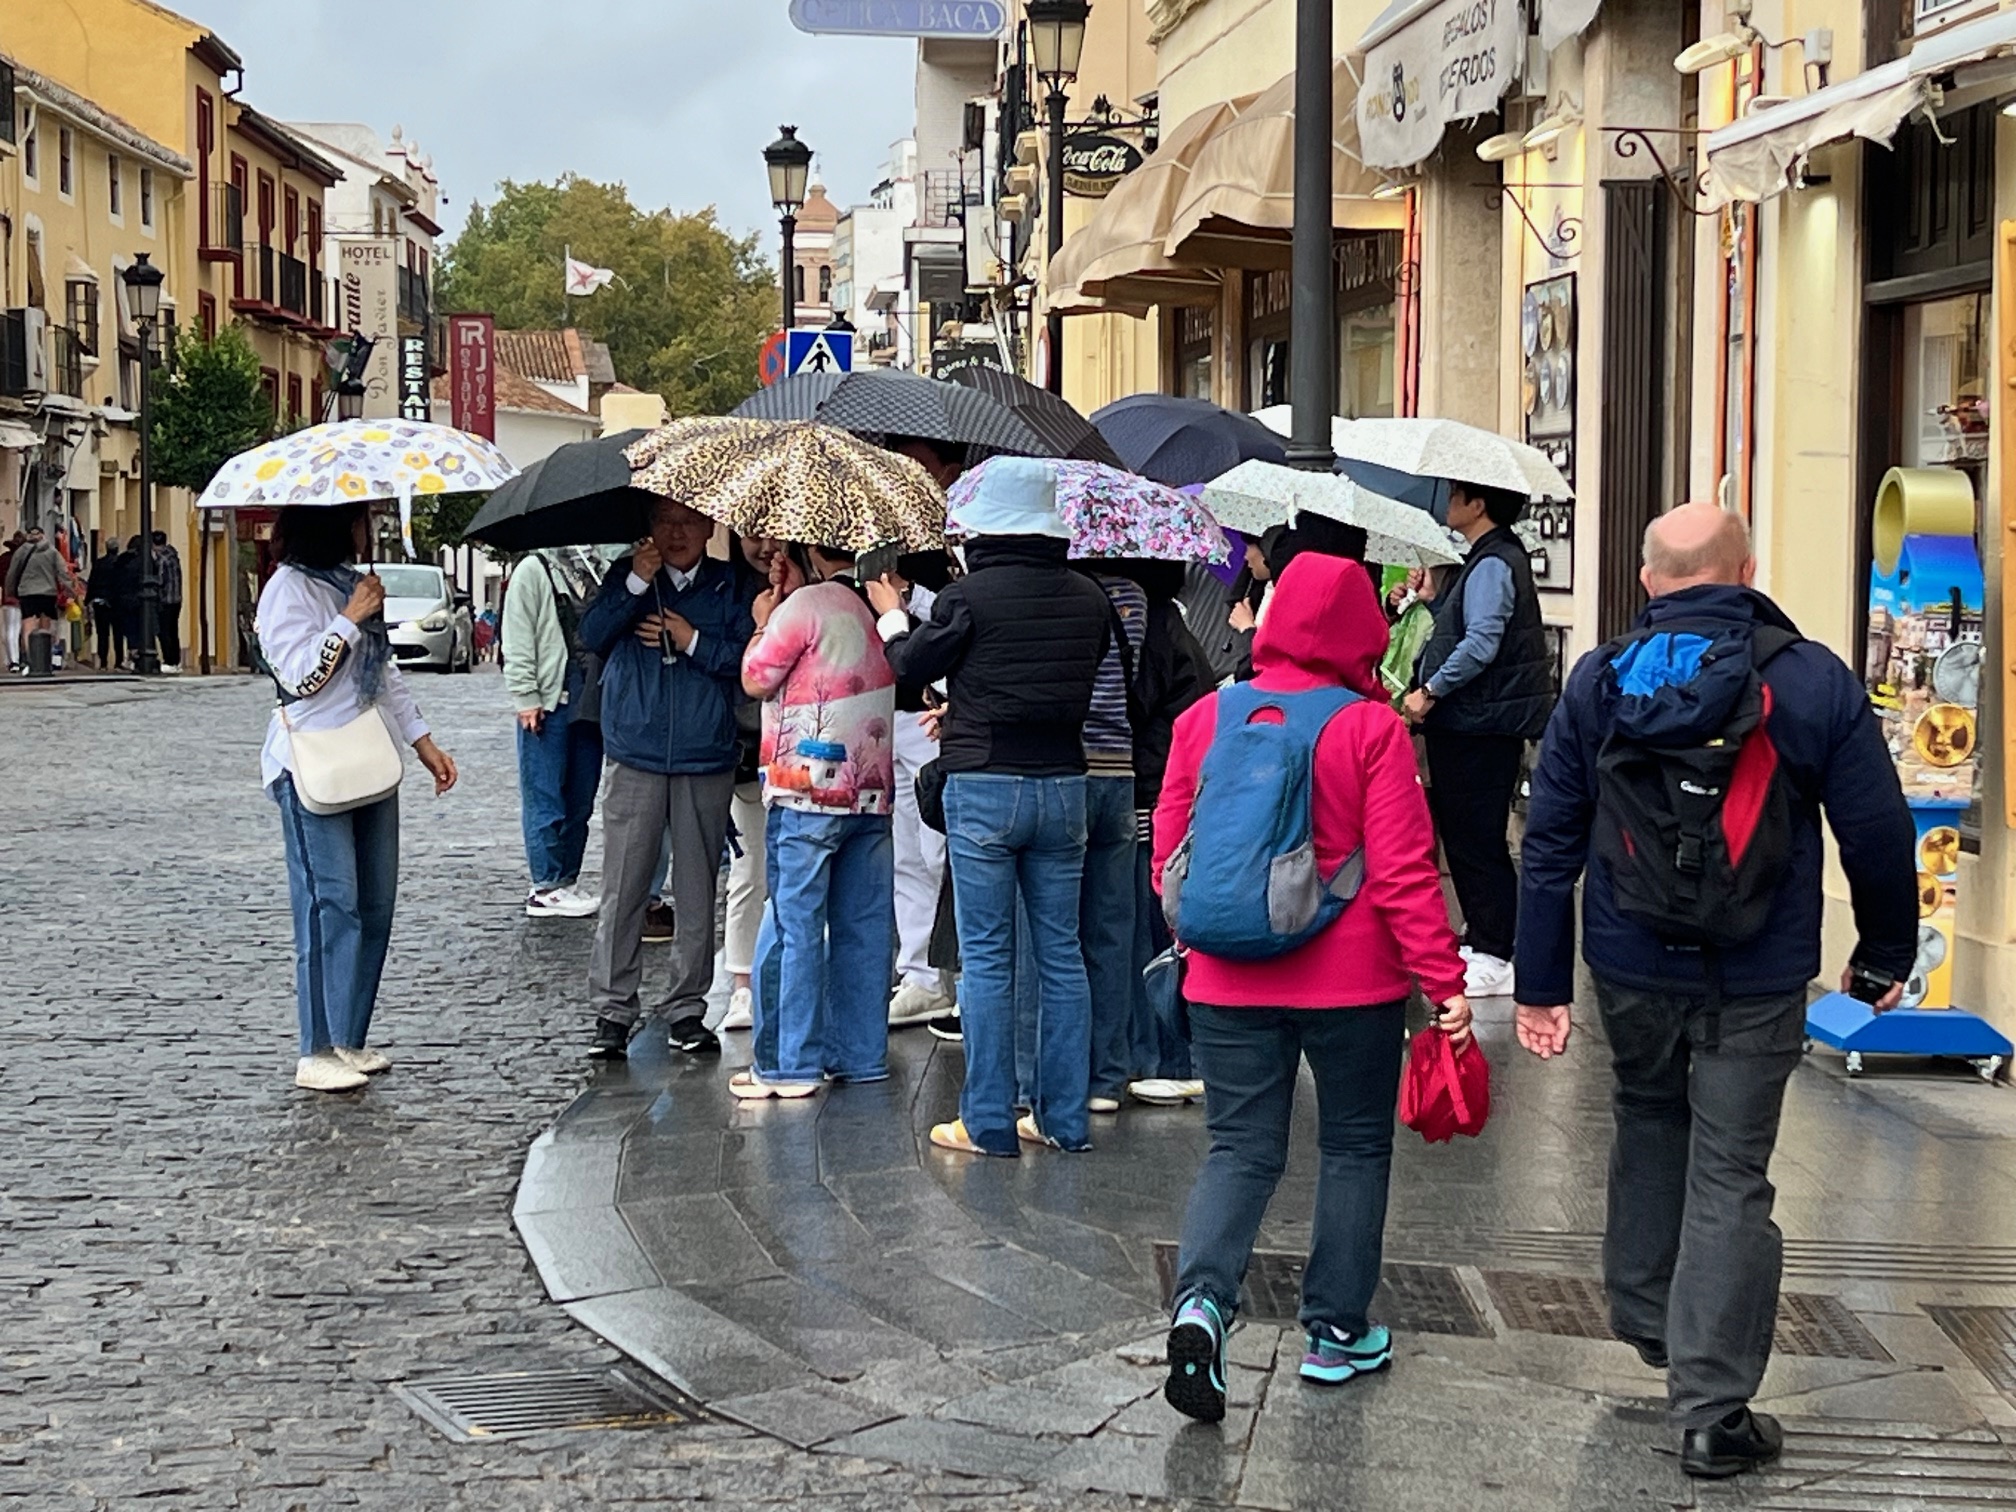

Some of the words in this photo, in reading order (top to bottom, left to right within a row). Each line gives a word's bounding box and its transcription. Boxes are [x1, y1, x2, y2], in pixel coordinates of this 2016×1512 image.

[918, 2, 992, 31] BACA
[342, 246, 391, 259] HOTEL
[342, 272, 361, 336] rante
[404, 338, 426, 420] RESTAU
